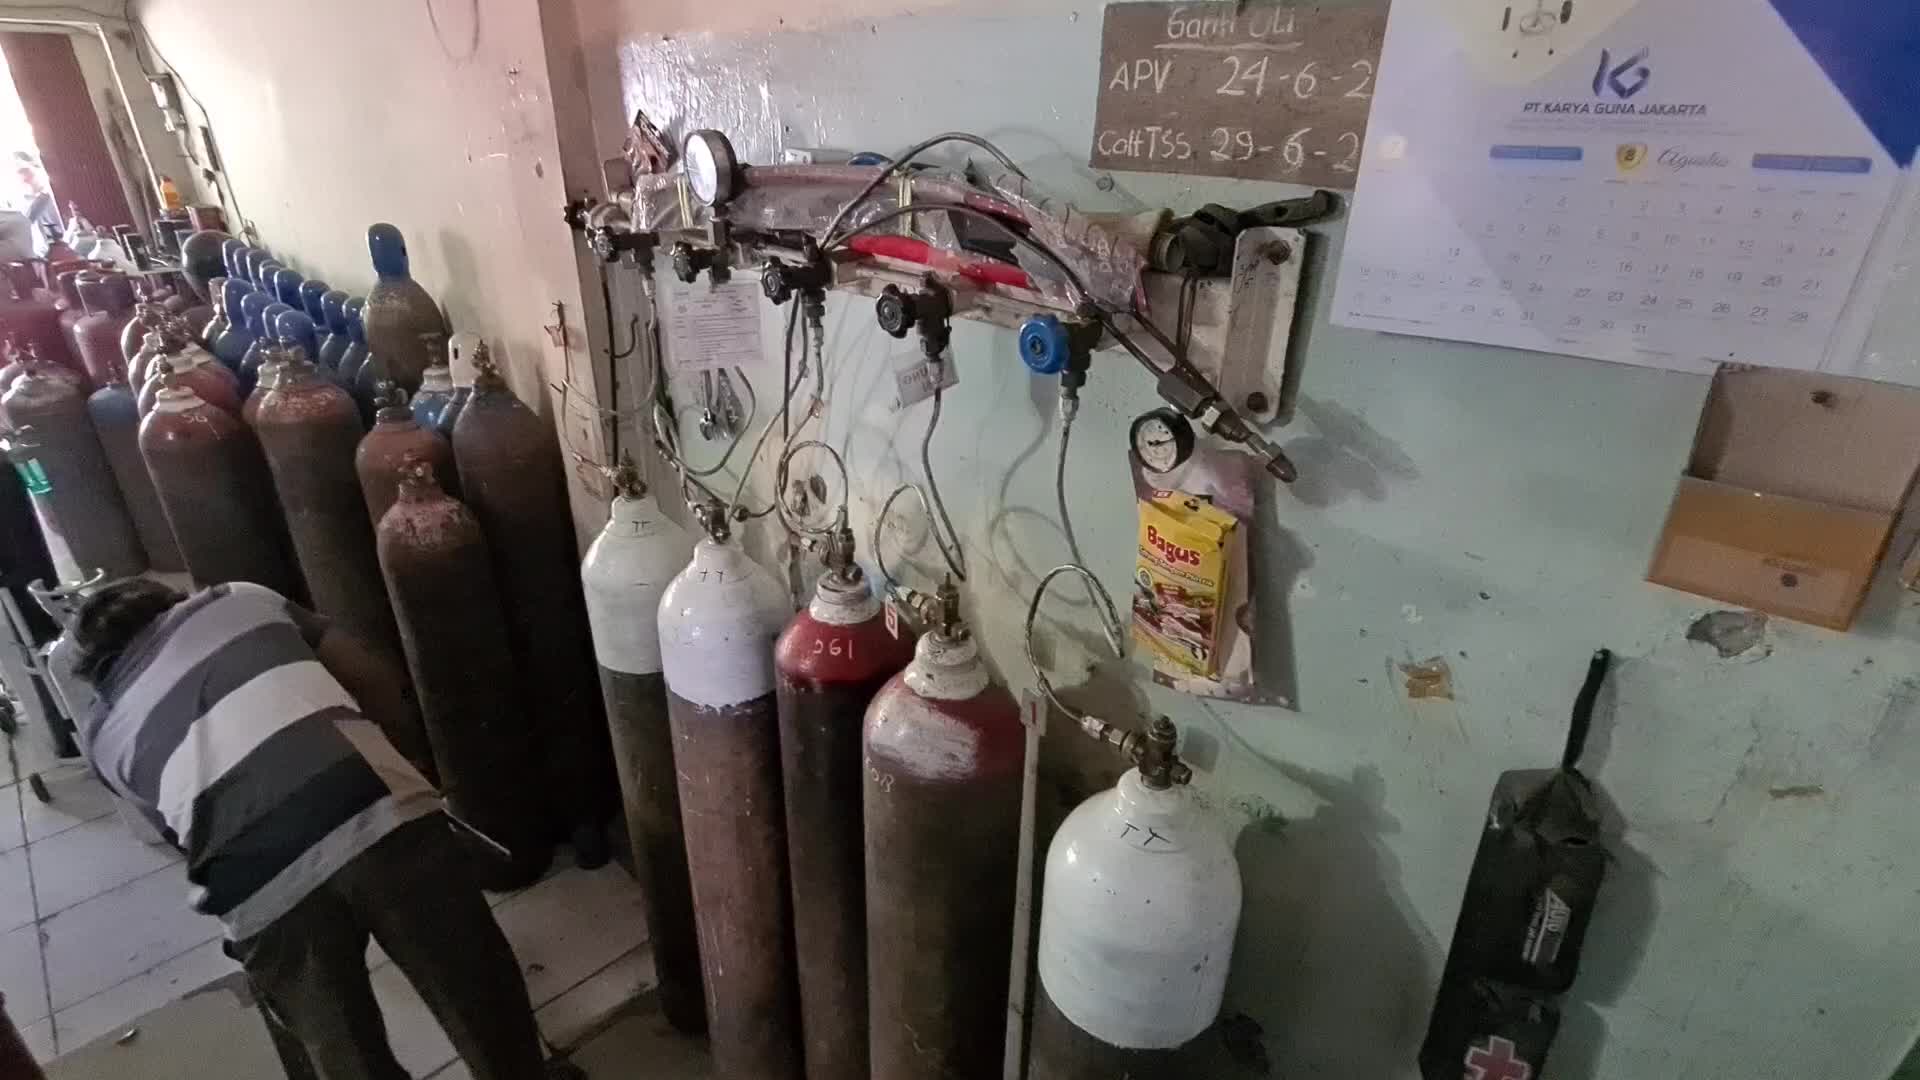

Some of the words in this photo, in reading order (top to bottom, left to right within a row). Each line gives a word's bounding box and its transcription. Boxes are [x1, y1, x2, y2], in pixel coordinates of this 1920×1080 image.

[1108, 58, 1173, 93] APV
[1543, 103, 1590, 114] KARYA
[1594, 103, 1636, 115] GUNA
[1638, 103, 1708, 117] JAKARTA
[1147, 524, 1201, 567] Bagus
